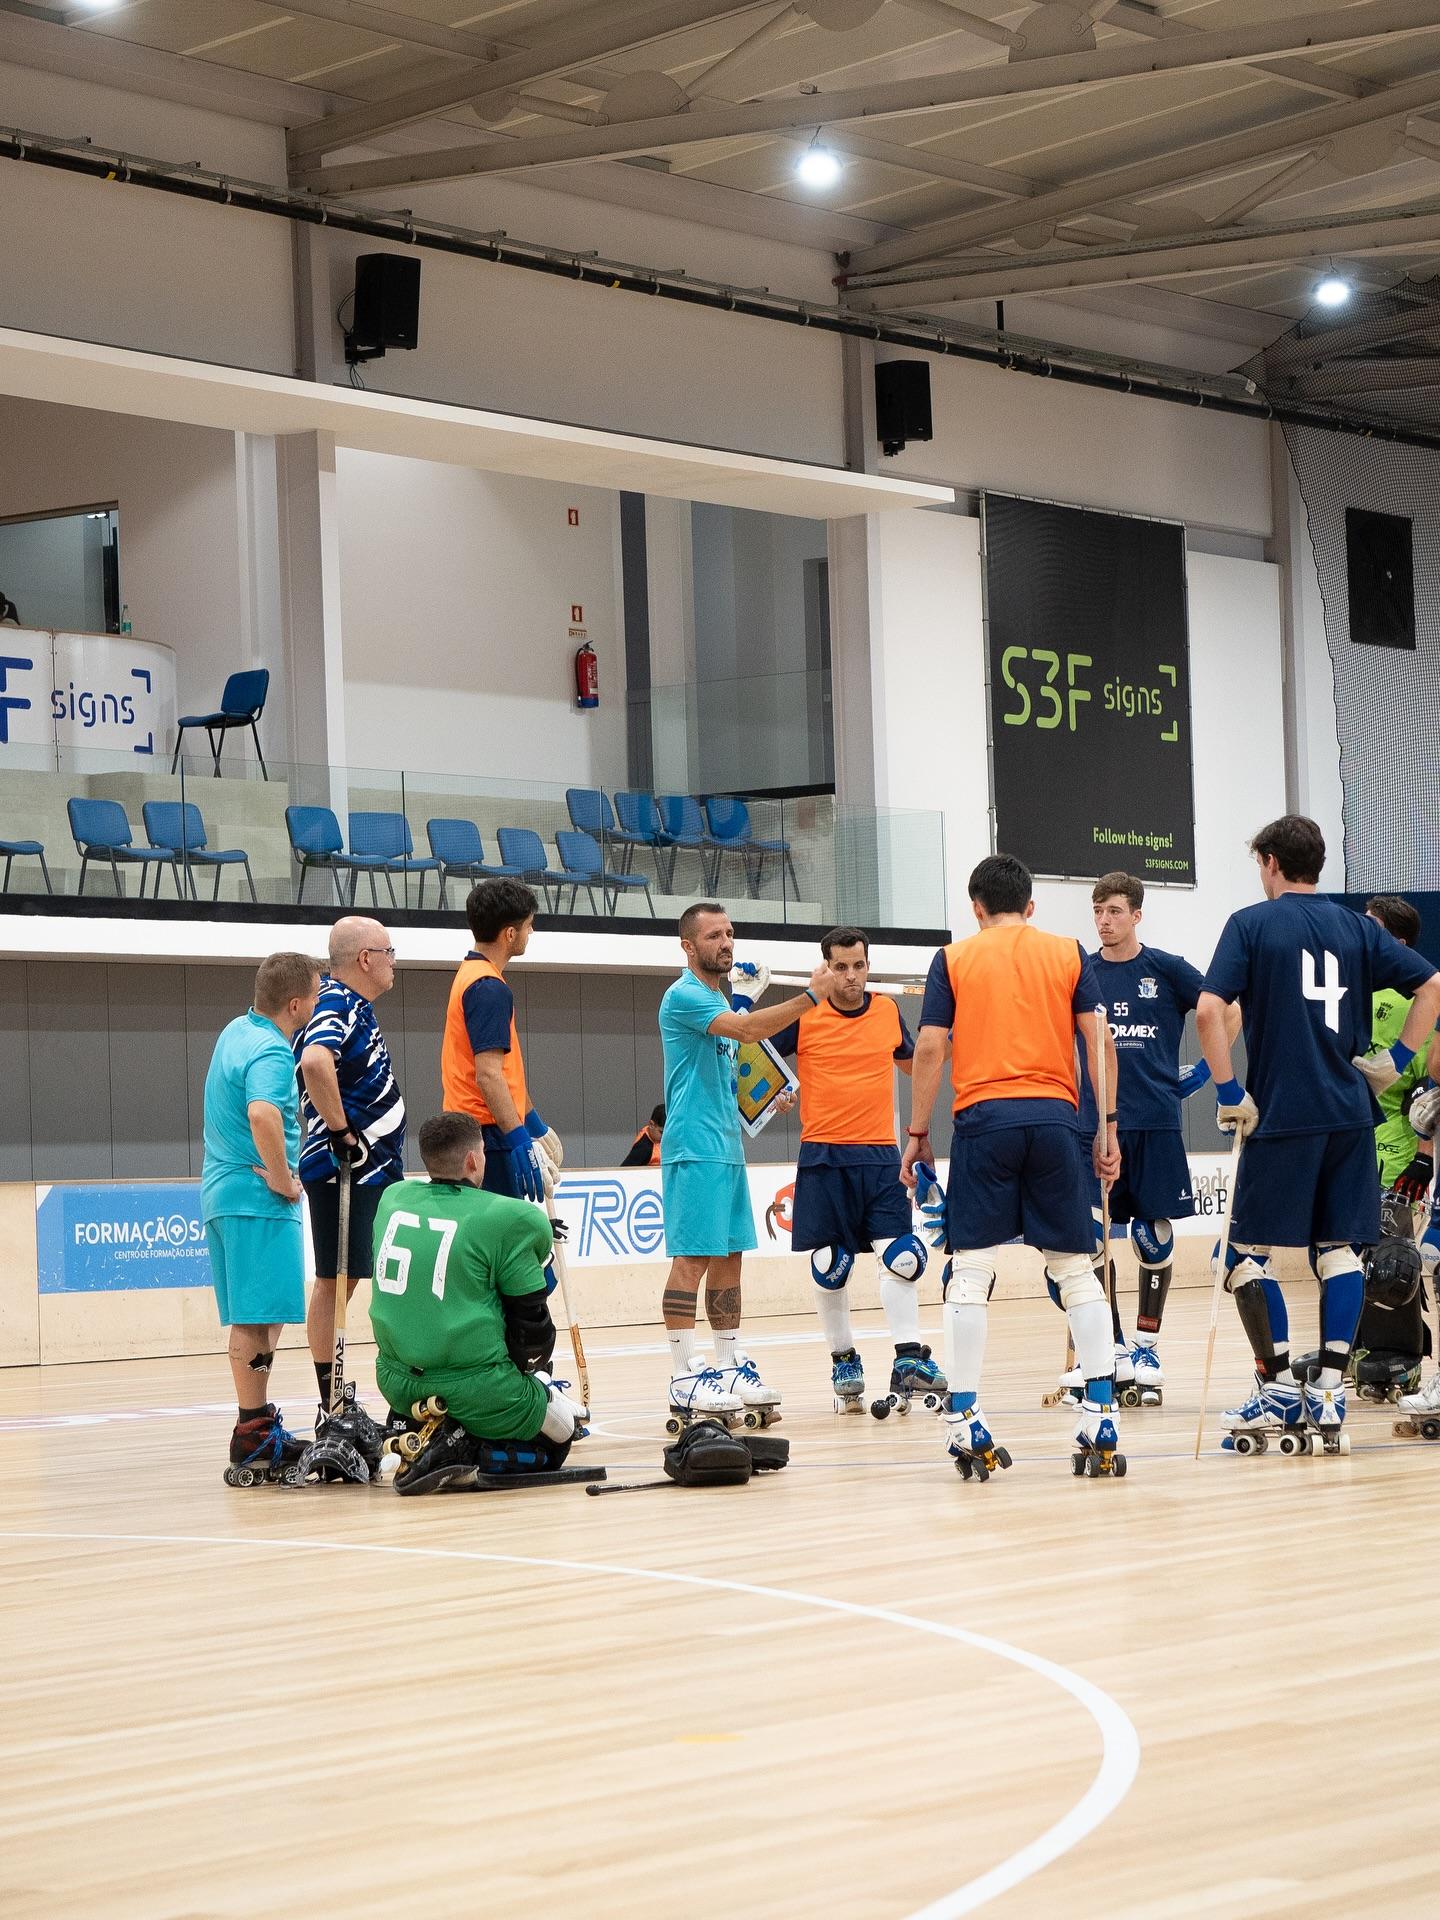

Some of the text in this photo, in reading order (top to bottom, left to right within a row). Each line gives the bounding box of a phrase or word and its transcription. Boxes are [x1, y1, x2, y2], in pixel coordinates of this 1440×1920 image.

[1001, 645, 1162, 732] S3F signs
[51, 682, 134, 727] signs
[1093, 827, 1173, 851] Follow the signs!
[1145, 858, 1189, 870] S3FSIGNS.COM
[1302, 948, 1348, 1034] 4
[1113, 1002, 1129, 1016] 55
[1193, 1190, 1213, 1216] de
[114, 1246, 209, 1260] CENTRO DE FORMAÇÃO DE MOT
[376, 1210, 458, 1301] 67
[1150, 1274, 1159, 1289] 5
